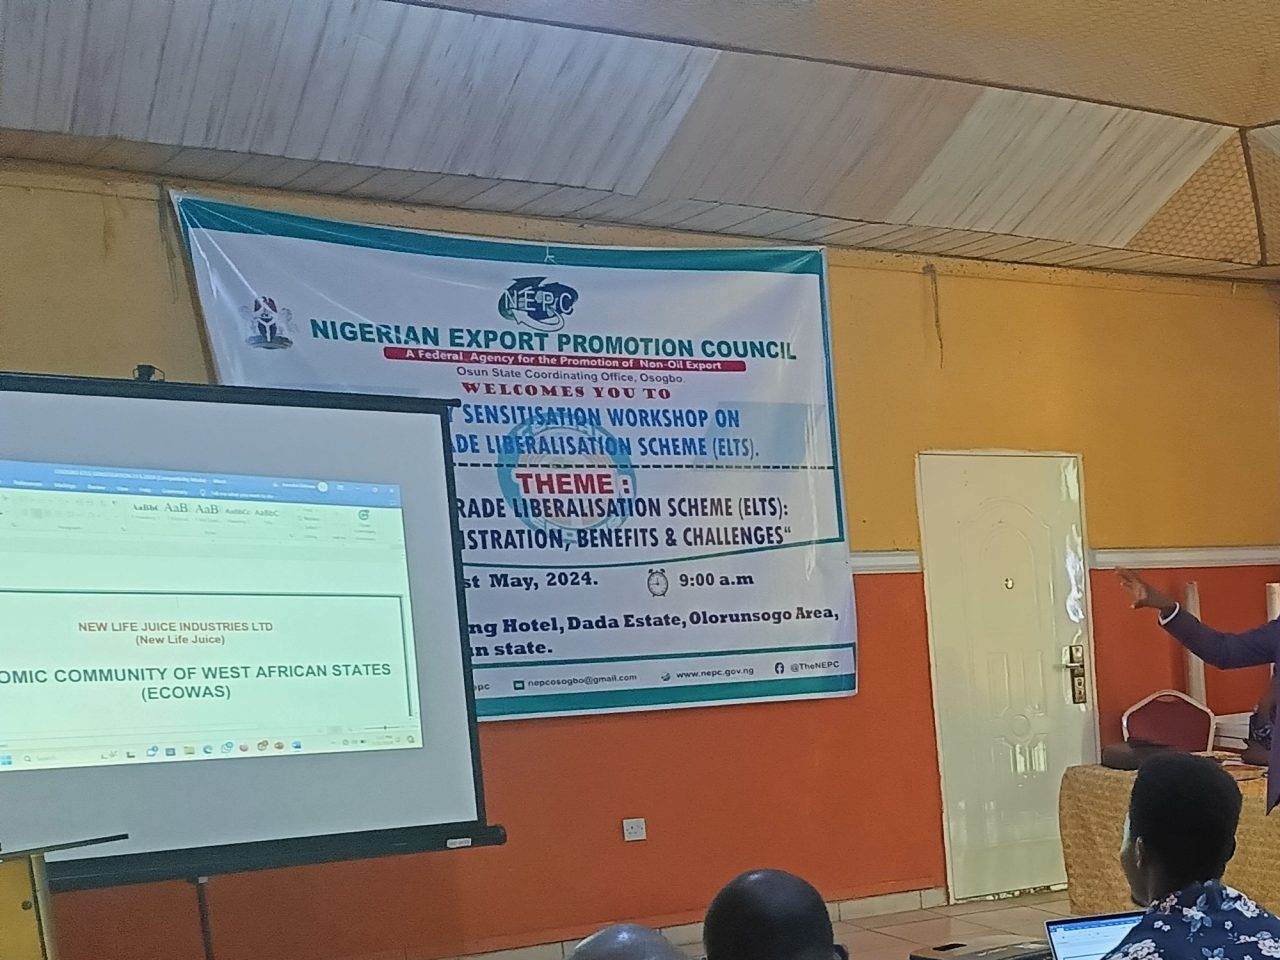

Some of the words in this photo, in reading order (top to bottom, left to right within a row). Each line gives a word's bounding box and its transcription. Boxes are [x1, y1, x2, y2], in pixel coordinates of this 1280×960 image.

[504, 289, 573, 313] NEPC
[310, 319, 440, 346] NIGERIAN
[450, 328, 549, 351] EXPORT
[557, 333, 693, 357] PROMOTION
[701, 339, 797, 360] COUNCIL
[406, 350, 415, 358] A
[418, 351, 463, 361] Federal
[470, 353, 515, 365] Agency
[517, 353, 534, 364] for
[539, 355, 557, 365] the
[560, 356, 619, 367] Promotion
[622, 358, 634, 368] of
[640, 359, 684, 369] Non-Oil
[686, 361, 722, 371] Export
[456, 366, 489, 377] Osun
[492, 366, 522, 378] State
[525, 368, 598, 383] Coordinating
[600, 373, 637, 383] Office,
[640, 373, 686, 385] Osogbo.
[462, 382, 585, 398] WELCOMES
[592, 386, 635, 399] YOU
[642, 387, 671, 399] TO
[462, 403, 601, 427] SENSITISATION
[606, 407, 708, 428] WORKSHOP
[715, 409, 740, 428] ON
[486, 434, 632, 456] LIBERALISATION
[639, 437, 707, 457] SCHEME
[712, 436, 759, 459] (ELTS).
[515, 473, 614, 494] THEME
[513, 498, 661, 518] LIBERALISATION
[668, 497, 733, 517] SCHEME
[738, 497, 789, 520] (ELTS):
[577, 528, 659, 548] BENEFITS
[665, 527, 677, 546] &
[489, 573, 539, 590] May,
[546, 571, 598, 586] 2024.
[679, 573, 715, 587] 9:00
[719, 575, 754, 586] a.m
[78, 622, 108, 632] NEW
[111, 622, 138, 632] LIFE
[141, 622, 176, 632] JUICE
[179, 622, 249, 632] INDUSTRIES
[252, 622, 273, 632] LTD
[502, 617, 564, 634] Hotel,
[567, 615, 620, 630] Dada
[623, 613, 687, 629] Estate,
[689, 609, 792, 625] Olorunsogo
[795, 606, 839, 621] Area,
[135, 635, 165, 646] (New
[168, 635, 189, 644] Life
[191, 634, 225, 646] Juice)
[494, 641, 553, 656] state.
[0, 670, 48, 684] OMIC
[54, 668, 167, 683] COMMUNITY
[173, 666, 197, 681] OF
[202, 666, 251, 680] WEST
[255, 664, 328, 678] AFRICAN
[332, 663, 391, 677] STATES
[676, 667, 754, 679] www.nepc.gov.ng
[790, 660, 840, 673] @TheNEPC
[527, 674, 638, 687] nepcosogbo@gmail.com
[141, 685, 231, 703] (ECOWAS)
